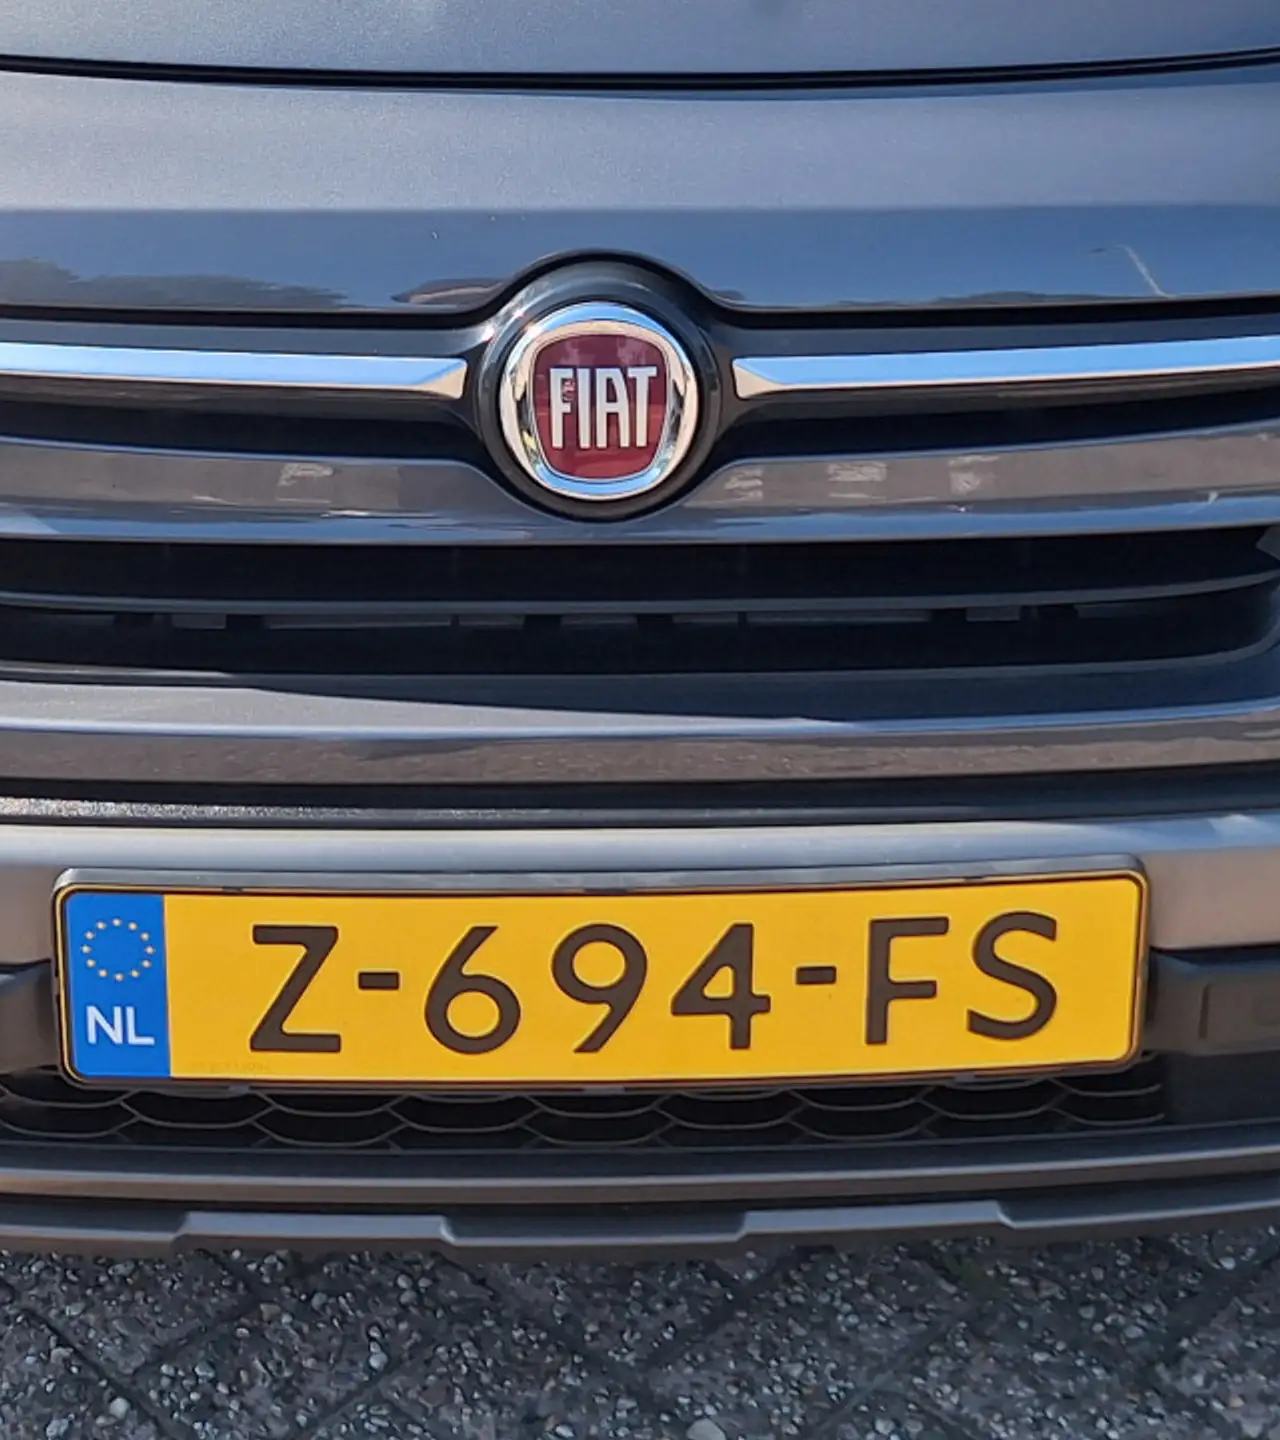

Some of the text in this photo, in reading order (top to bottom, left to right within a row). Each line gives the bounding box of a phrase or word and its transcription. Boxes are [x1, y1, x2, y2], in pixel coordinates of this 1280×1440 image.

[550, 366, 657, 449] FIAT
[250, 910, 1058, 1054] Z-694-FS
[86, 1005, 155, 1045] NL
